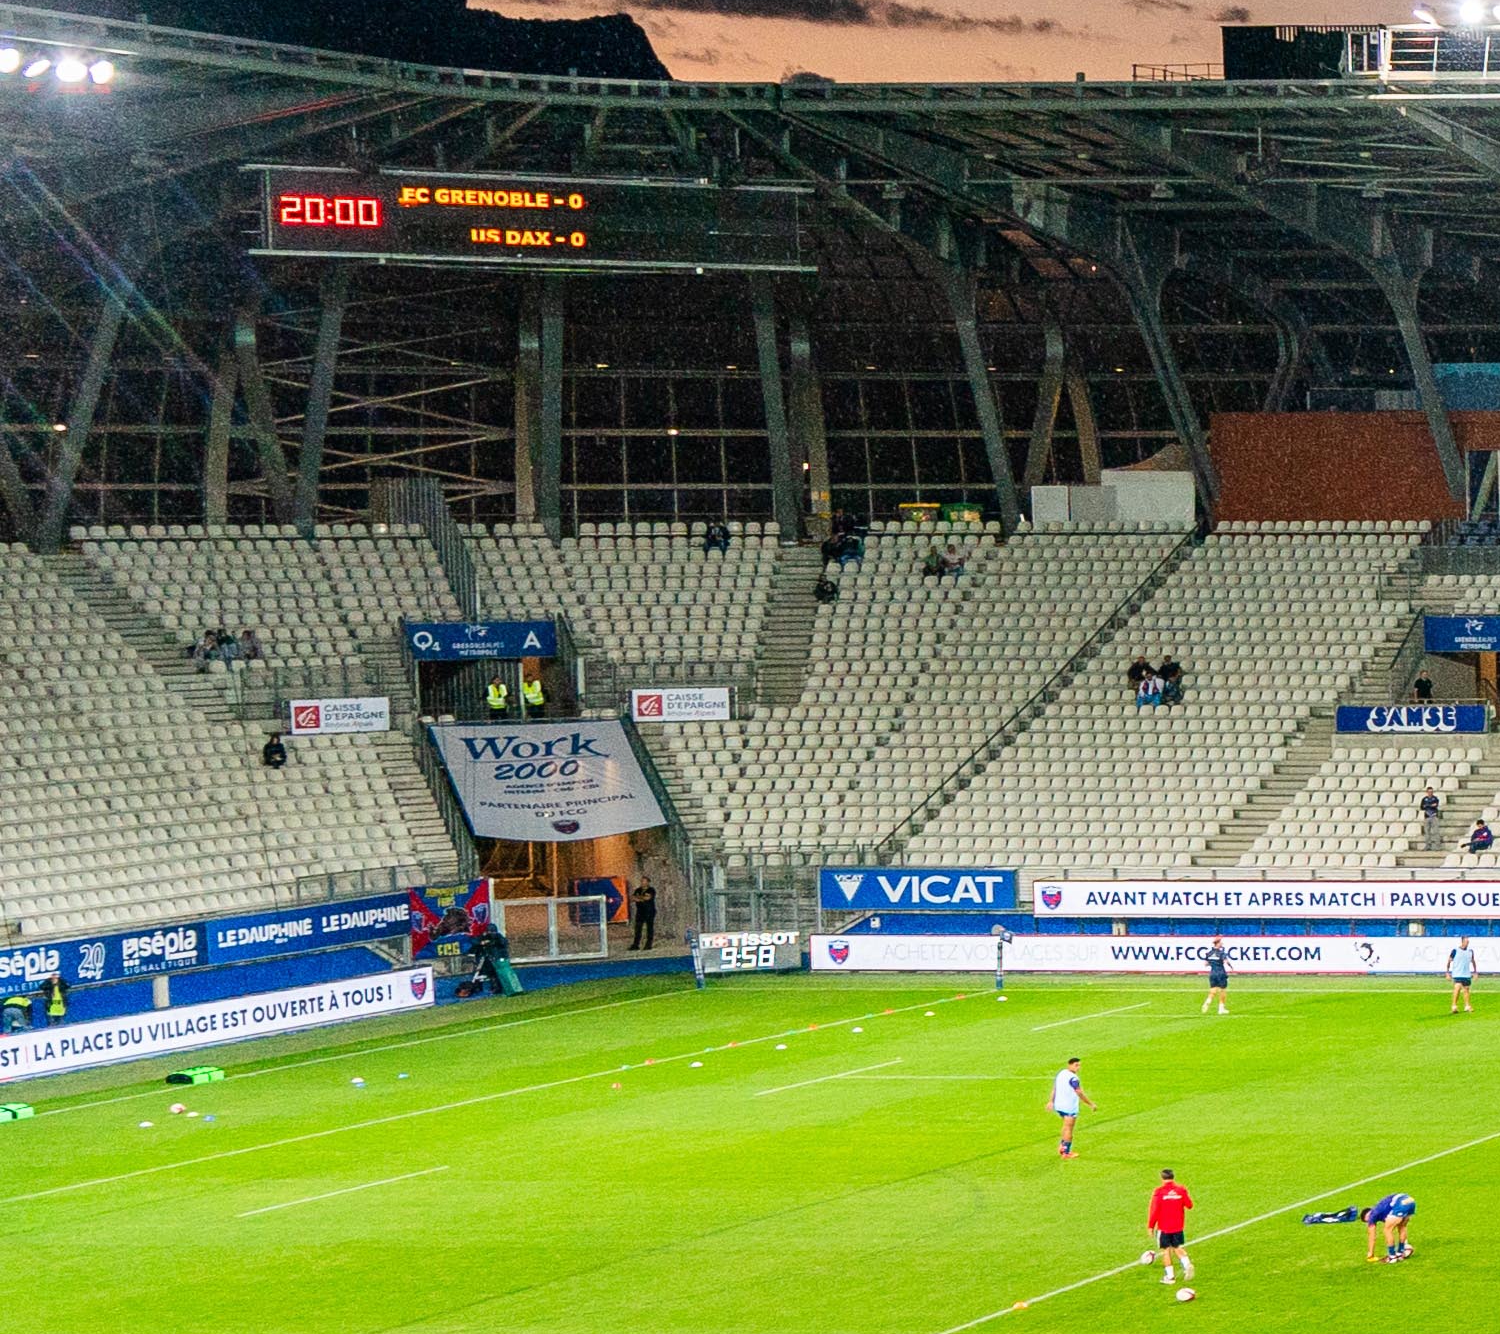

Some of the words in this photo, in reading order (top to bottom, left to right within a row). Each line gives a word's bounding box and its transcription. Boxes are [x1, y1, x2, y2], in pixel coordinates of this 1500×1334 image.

[280, 194, 381, 227] 20:00
[402, 187, 430, 204] FC
[435, 189, 549, 208] GRENOBLE
[569, 194, 584, 209] 0
[471, 229, 501, 244] US
[505, 230, 551, 246] DAX
[571, 232, 585, 247] 0
[523, 630, 541, 649] A
[324, 703, 362, 713] CAISSE
[667, 693, 704, 702] CAISSE
[1367, 706, 1456, 732] SAMSE
[460, 733, 611, 760] Work
[494, 760, 580, 780] 2000
[480, 801, 560, 810] PARTENAIRE
[566, 793, 635, 808] PRINCIPAL
[877, 875, 1003, 904] VICAT
[1085, 891, 1147, 906] AVANT
[1152, 891, 1219, 906] MATCH
[1224, 892, 1243, 906] ET
[1247, 892, 1304, 906] APRES
[1309, 892, 1376, 907] MATCH
[1390, 892, 1457, 907] PARVIS
[322, 914, 340, 933] LE
[340, 904, 410, 929] DAUPHINÉ
[217, 929, 238, 948] LE
[237, 918, 313, 946] DAUPHINÉ
[728, 931, 800, 948] TISSOT
[138, 928, 198, 961] sépia
[1111, 946, 1321, 962] WWW.FCGCKET.COM
[720, 945, 776, 969] 9:58
[34, 1045, 56, 1063] LA
[60, 1032, 114, 1059] PLACE
[118, 1026, 143, 1048] DU
[147, 1014, 217, 1043] VILLAGE
[222, 1008, 249, 1030] EST
[252, 995, 324, 1024] OUVERTE
[329, 988, 339, 1011] À
[342, 985, 383, 1008] TOUS
